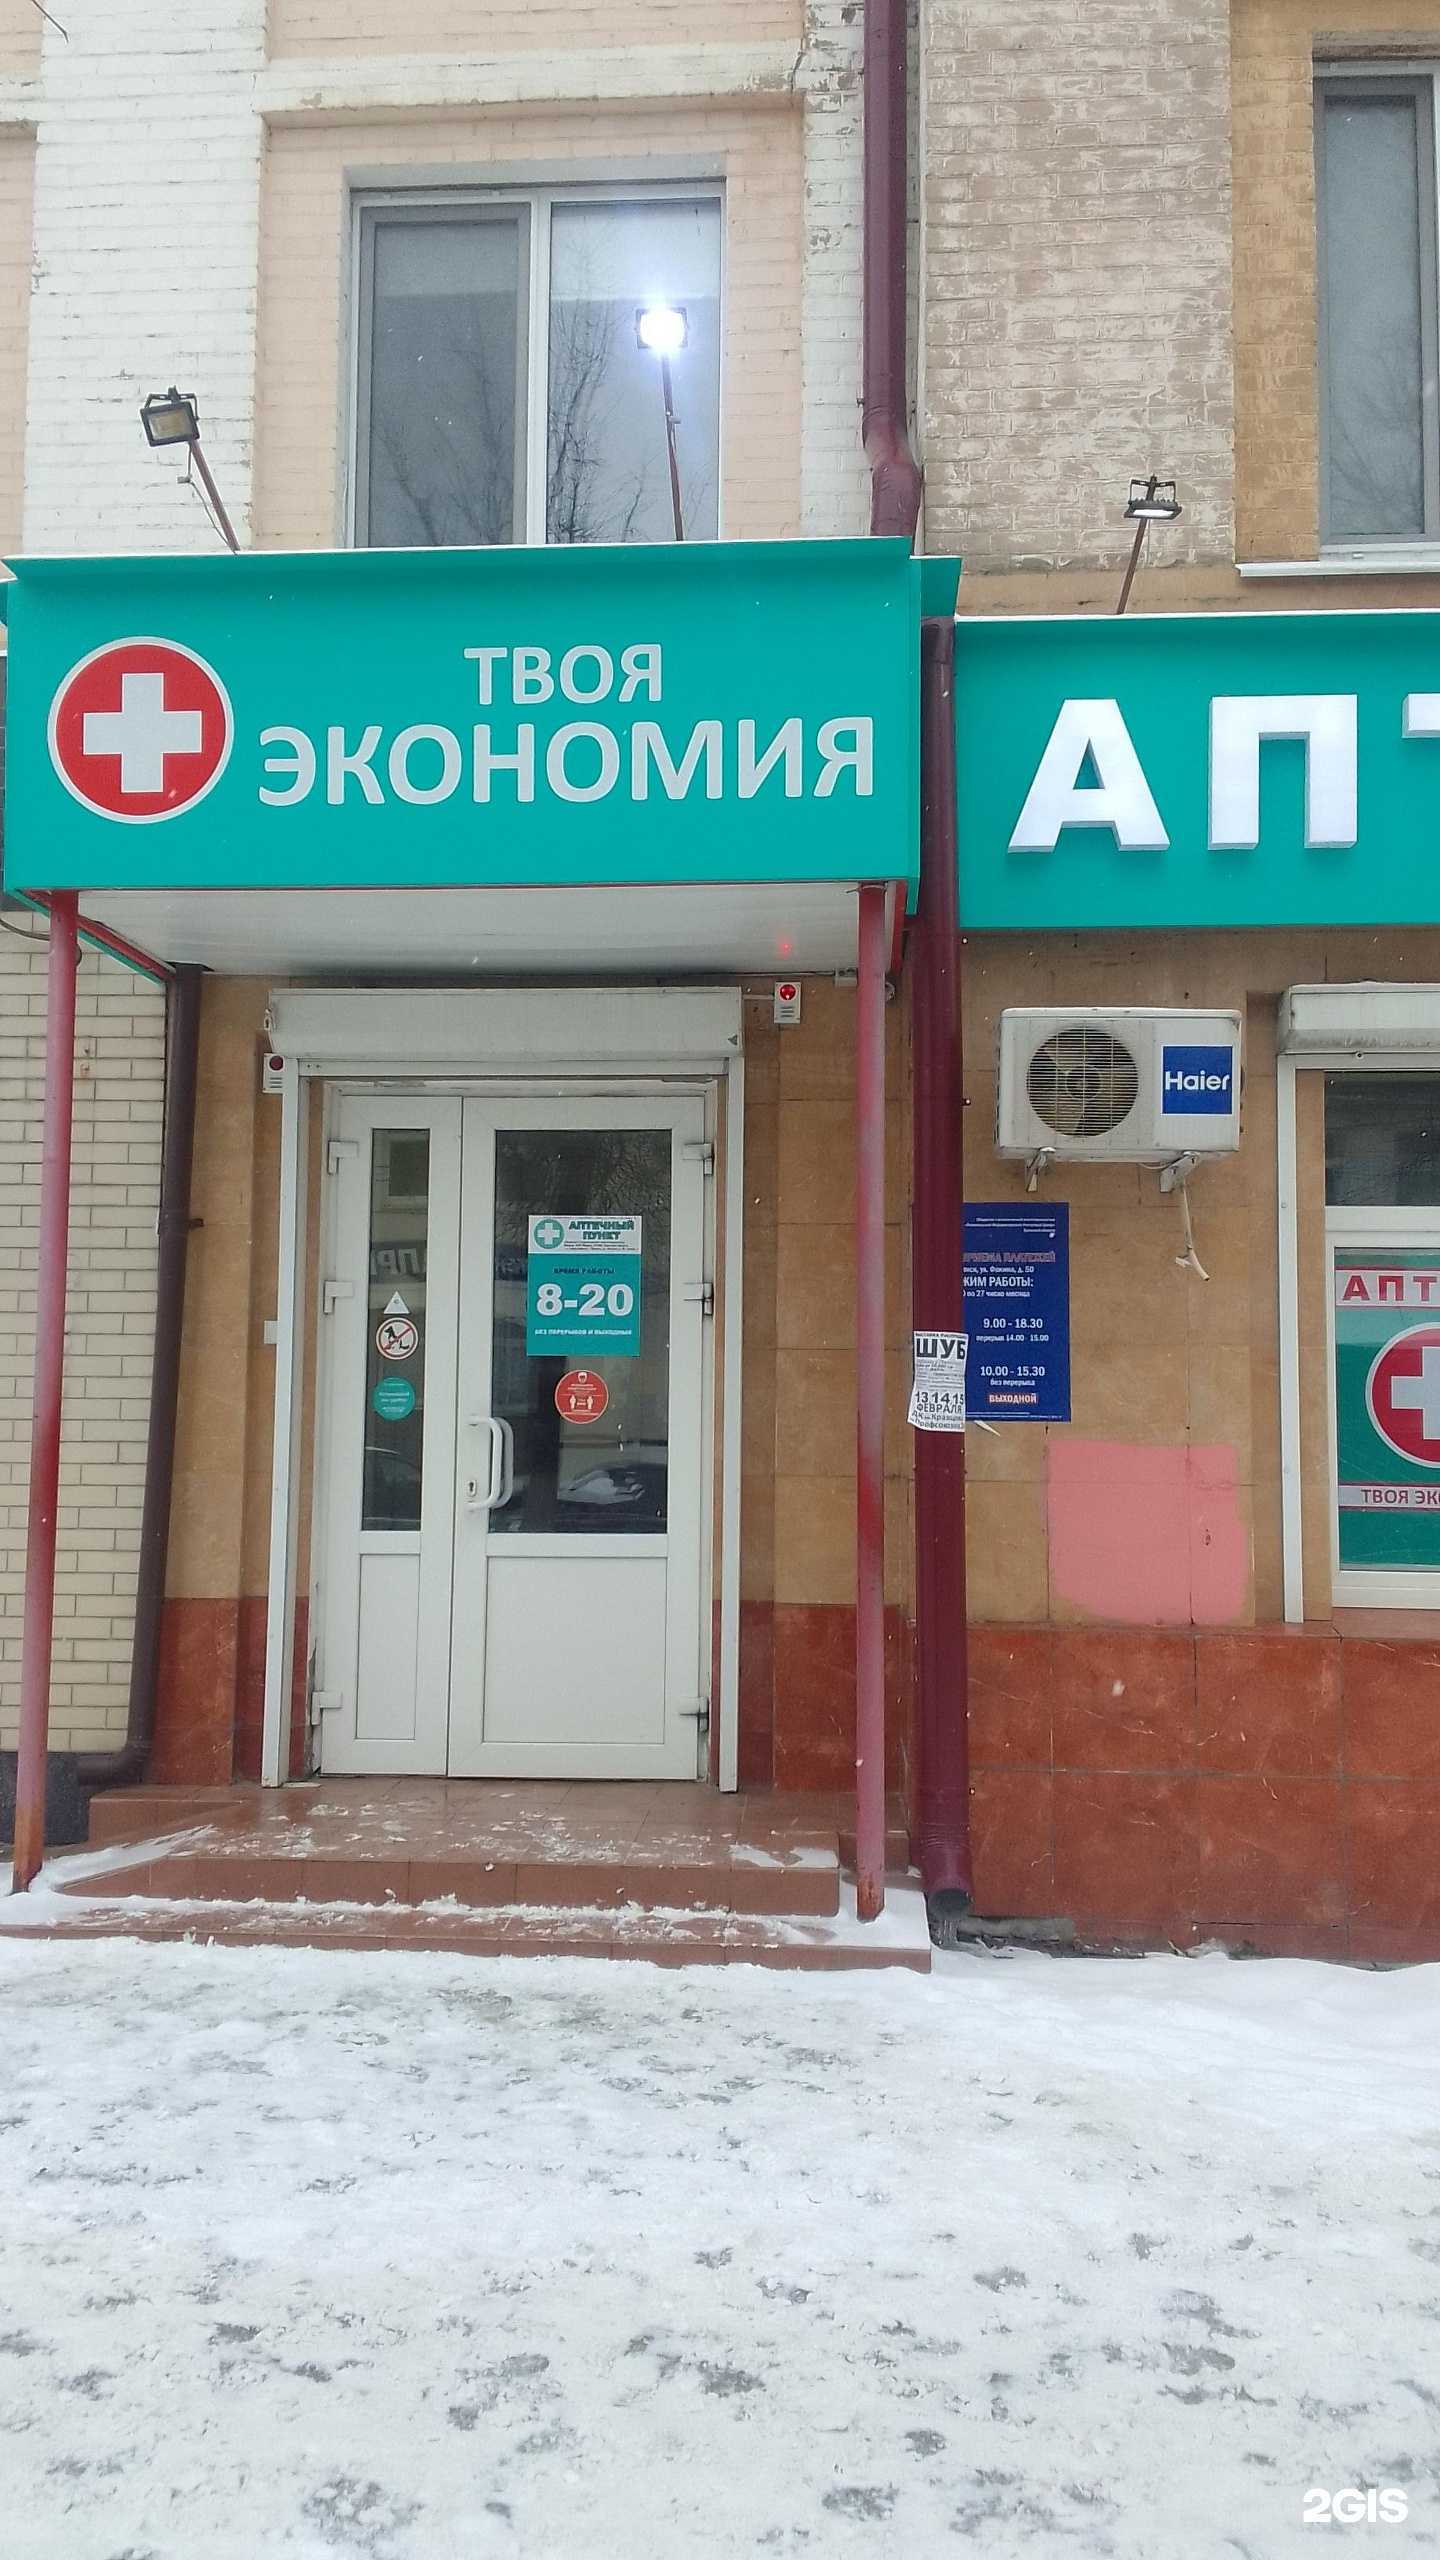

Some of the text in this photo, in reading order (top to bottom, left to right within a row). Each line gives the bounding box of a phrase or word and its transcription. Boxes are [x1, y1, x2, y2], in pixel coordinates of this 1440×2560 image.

[464, 643, 662, 705] ТВОЯ
[258, 716, 875, 805] ЭКОНОМИЯ
[1007, 693, 1440, 853] АП
[1165, 1070, 1230, 1090] Haier
[569, 1219, 635, 1230] АПТЕЧНЫЙ
[582, 1231, 621, 1240] ПУНКТ
[989, 1276, 1034, 1287] РАБОТЫ:
[1342, 1275, 1438, 1301] АПТ
[537, 1283, 634, 1316] 8-20
[983, 1318, 1006, 1329] 9.00
[1014, 1318, 1043, 1329] 18.30
[1006, 1334, 1025, 1342] 14.00
[1030, 1334, 1049, 1342] 15.00
[916, 1338, 966, 1359] ШУБ
[980, 1366, 1008, 1377] 10.00
[1016, 1366, 1045, 1377] 15.30
[989, 1393, 1037, 1404] ВЫХОДНОЙ
[917, 1403, 962, 1414] ФЕВРАЛЯ
[1361, 1489, 1440, 1505] ТВОЯ ЭК
